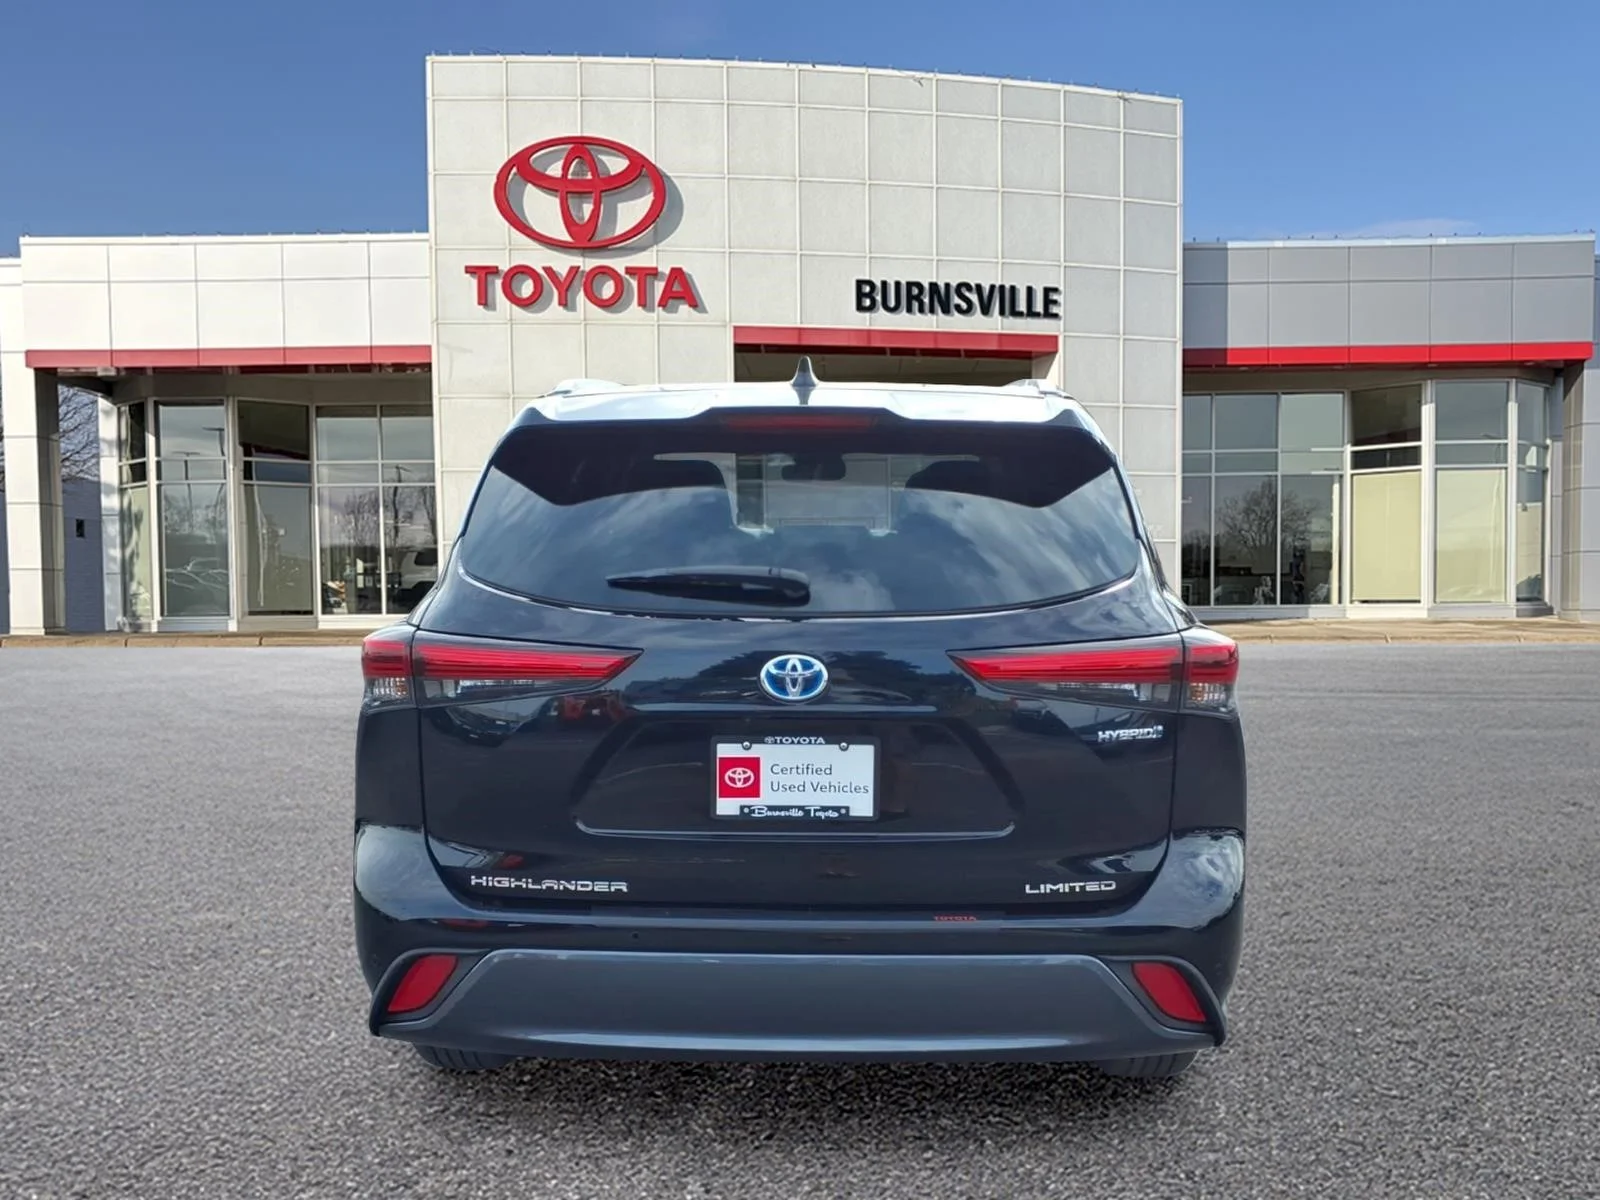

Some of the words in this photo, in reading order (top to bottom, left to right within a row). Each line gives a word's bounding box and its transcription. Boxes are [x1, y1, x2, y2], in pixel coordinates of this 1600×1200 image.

[465, 264, 699, 309] TOYOTA
[855, 278, 1061, 319] BURNSVILLE
[774, 736, 826, 745] TOYOTA
[1097, 727, 1154, 742] HYBRID
[770, 763, 833, 776] Certified
[770, 781, 806, 793] Used
[810, 781, 869, 794] Vehicles
[470, 875, 628, 893] HIGHLANDER
[1025, 880, 1117, 894] LIMITED
